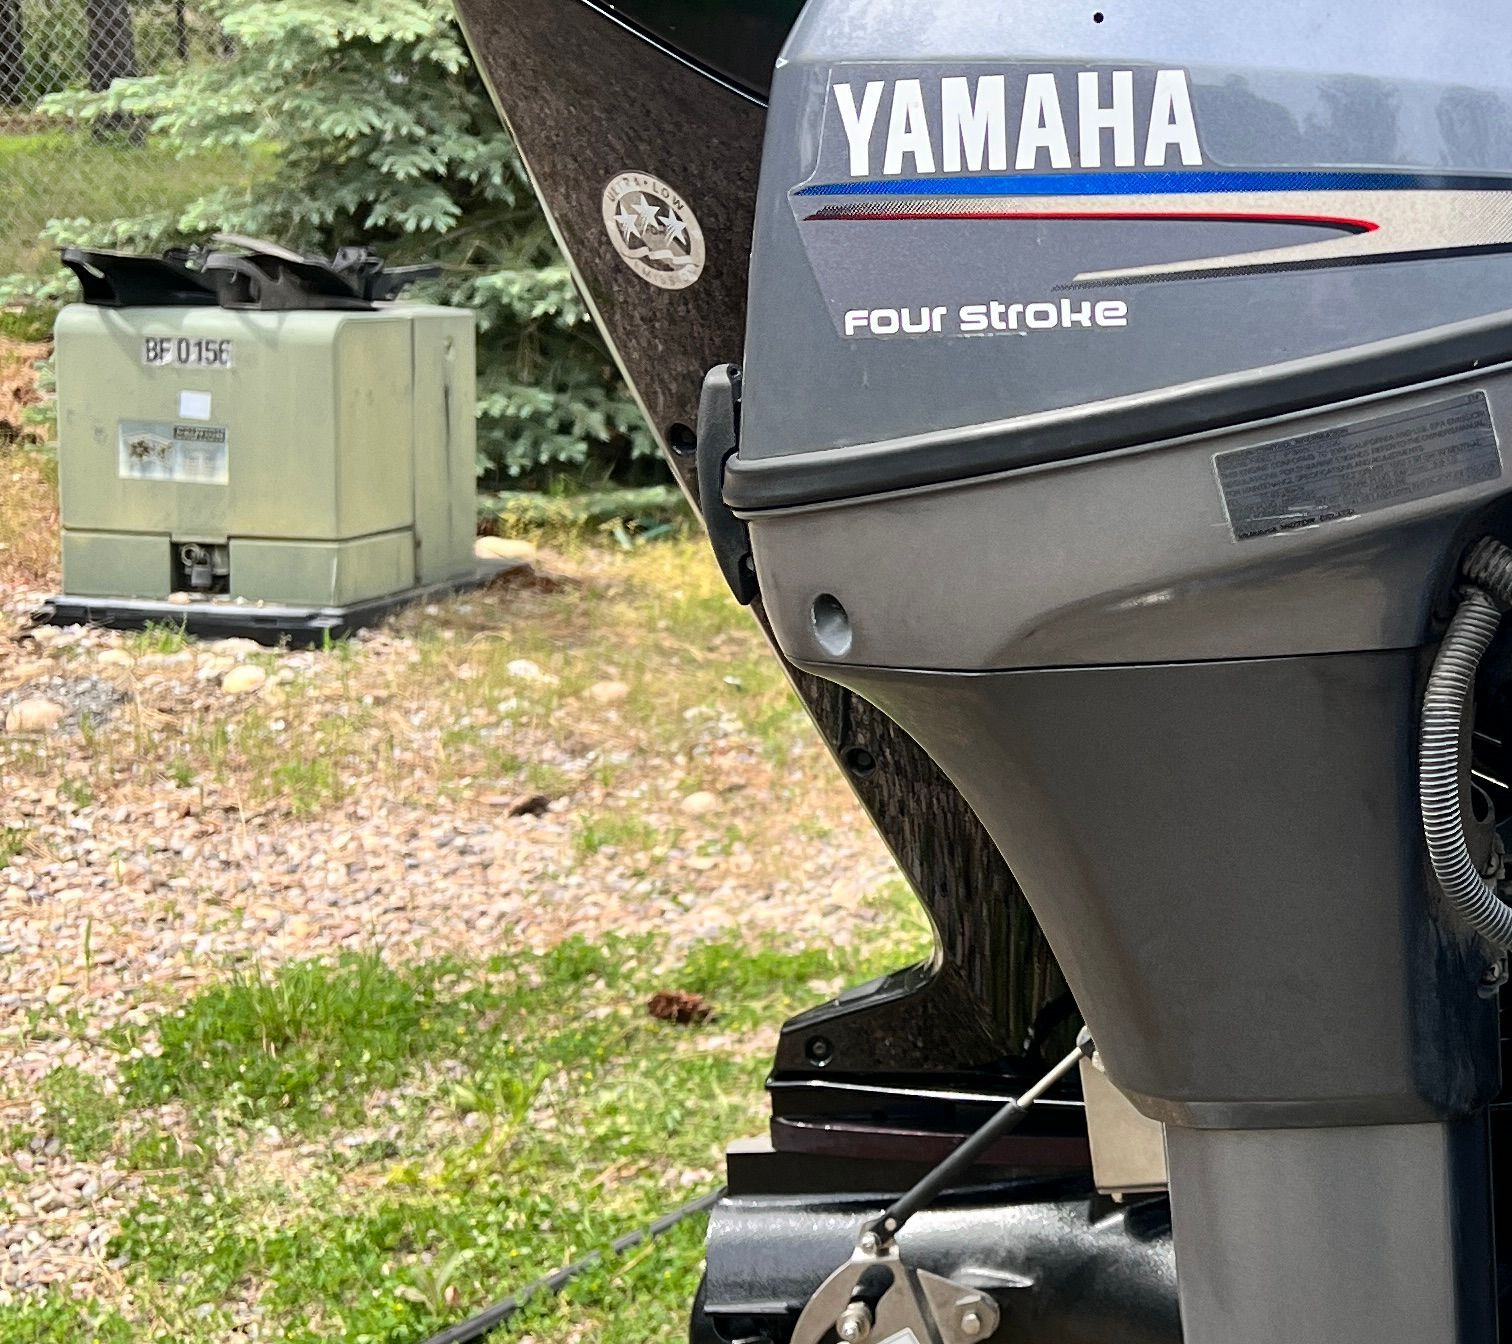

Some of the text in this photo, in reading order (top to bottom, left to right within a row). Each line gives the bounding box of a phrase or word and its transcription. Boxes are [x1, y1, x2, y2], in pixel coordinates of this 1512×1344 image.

[833, 69, 1202, 177] YAMAHA
[652, 183, 686, 211] LOW
[145, 337, 171, 362] BF
